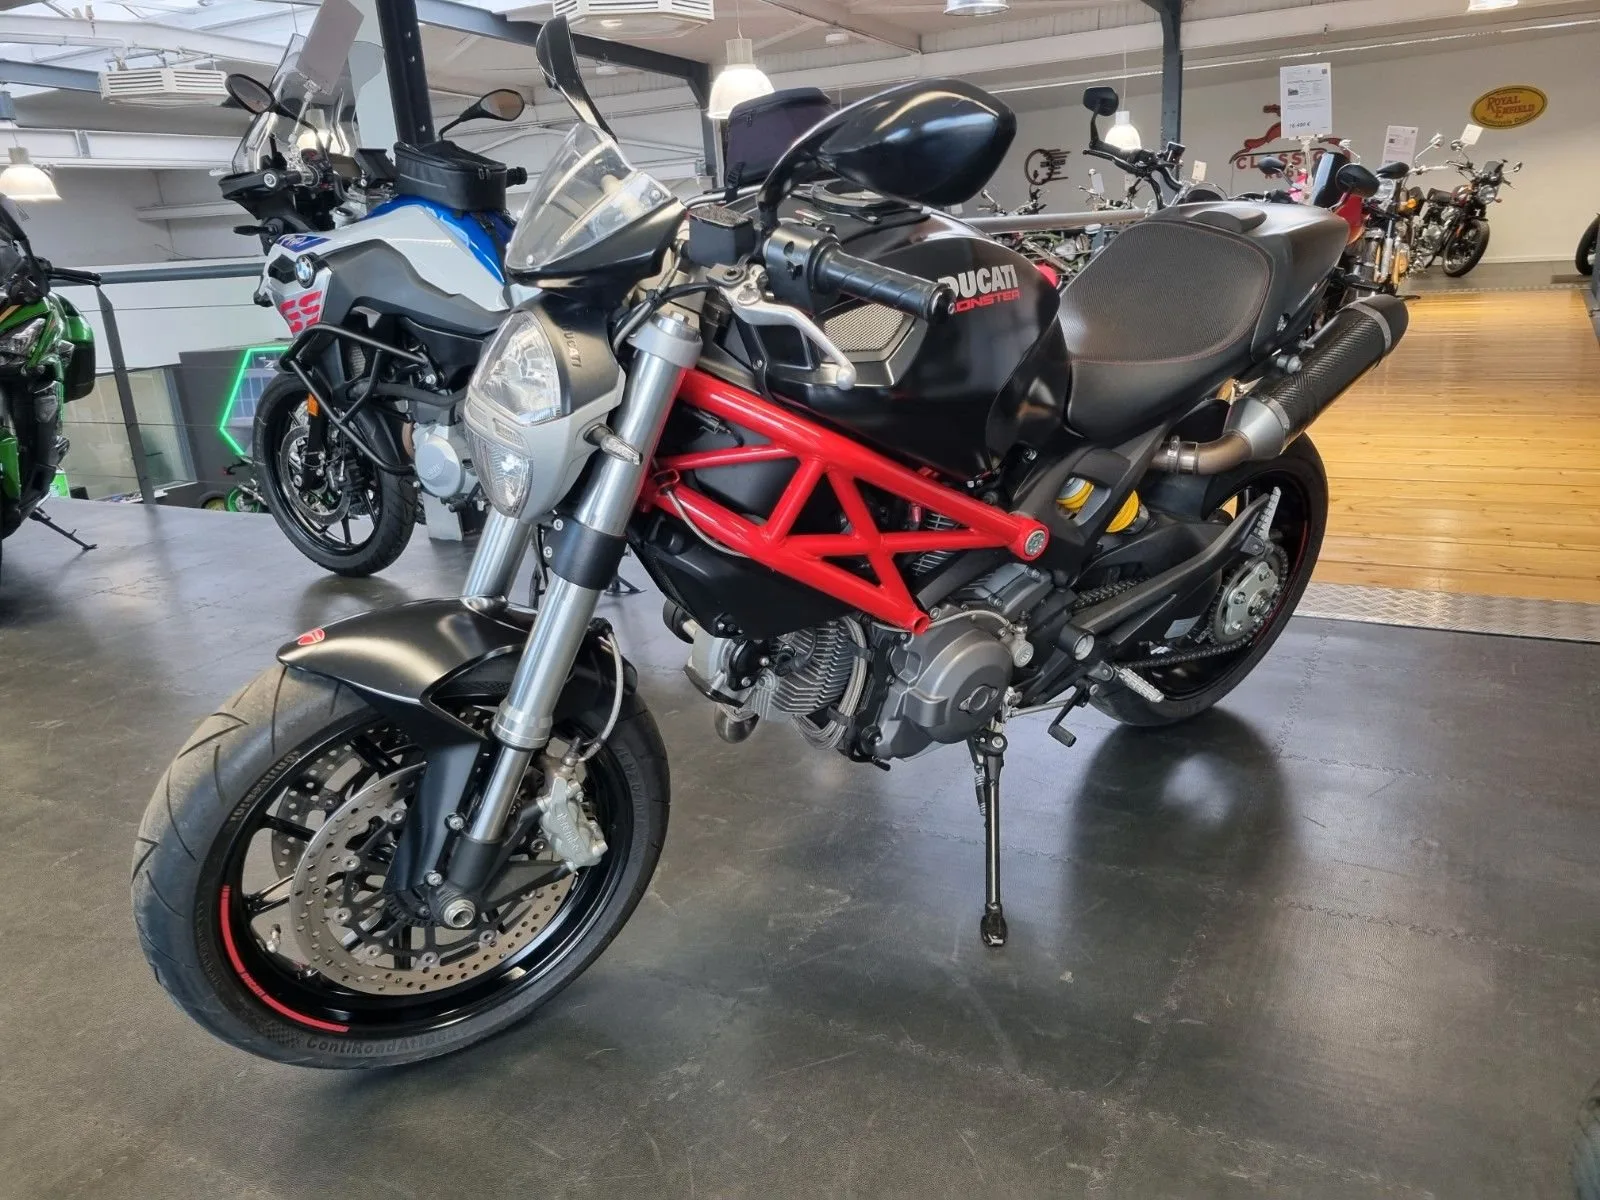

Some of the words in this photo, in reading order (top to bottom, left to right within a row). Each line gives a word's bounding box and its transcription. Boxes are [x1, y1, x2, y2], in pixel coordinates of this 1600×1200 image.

[1236, 151, 1326, 170] CLSSI
[937, 264, 1019, 299] DUCATI
[953, 288, 1021, 314] ONSTER
